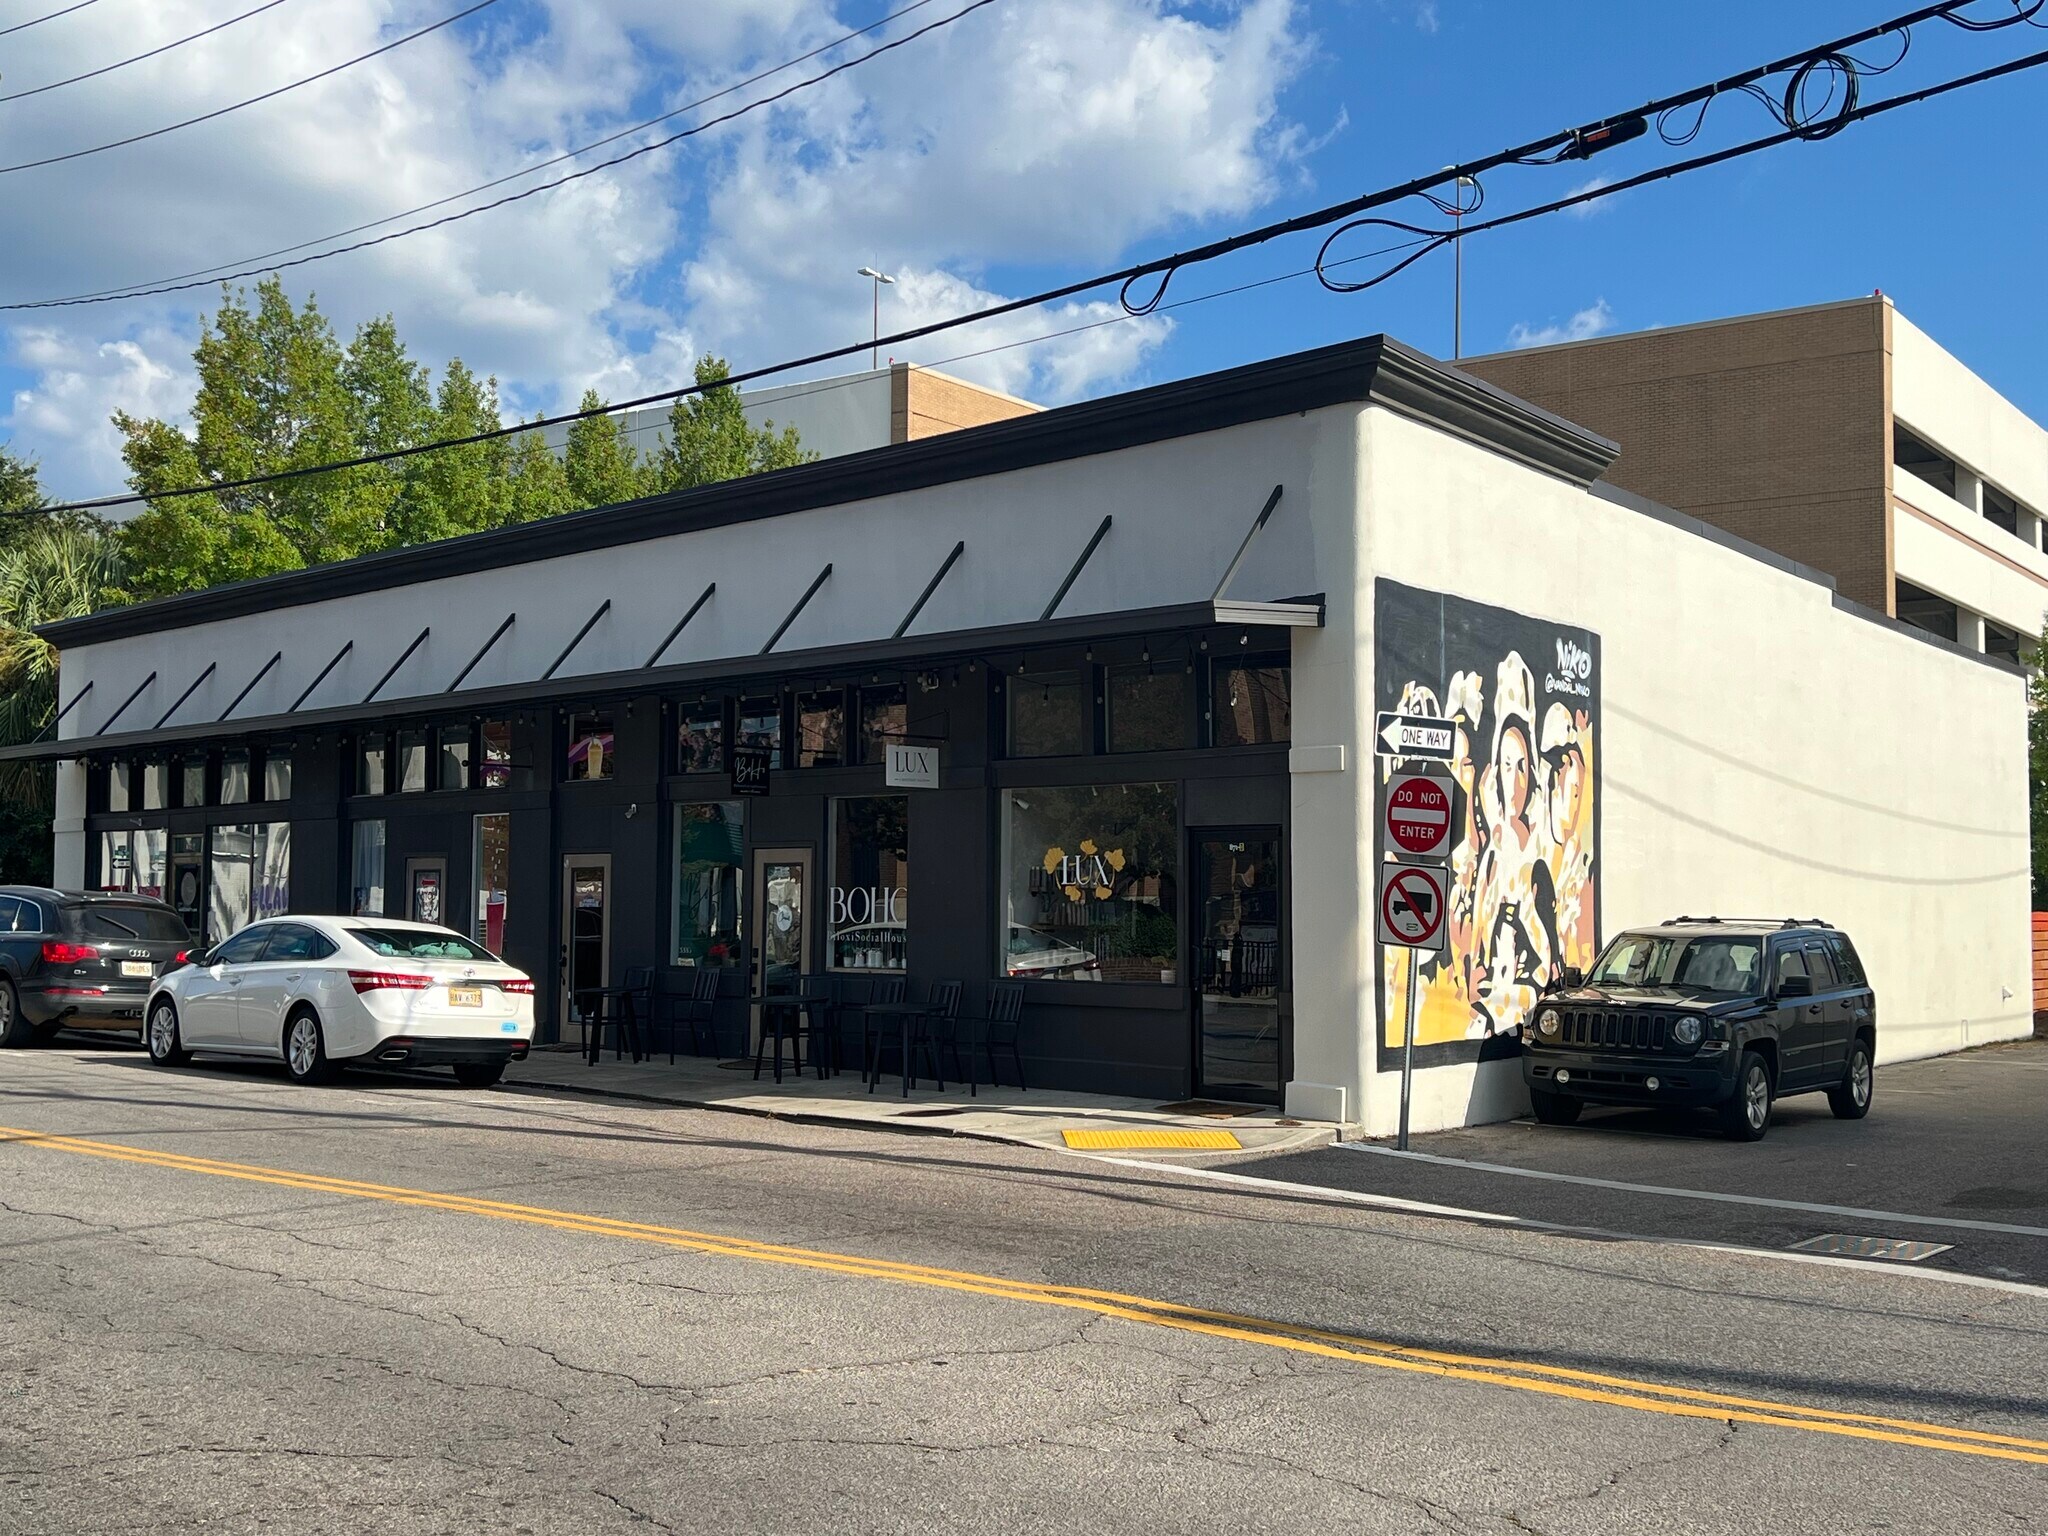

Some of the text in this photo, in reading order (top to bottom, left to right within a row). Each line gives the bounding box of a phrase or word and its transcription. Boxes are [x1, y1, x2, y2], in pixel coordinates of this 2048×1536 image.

[1401, 728, 1448, 747] ONE WAY
[895, 751, 929, 773] LUX
[1397, 790, 1442, 805] DO NOT
[1399, 825, 1435, 839] ENTER
[1061, 855, 1109, 886] LUX
